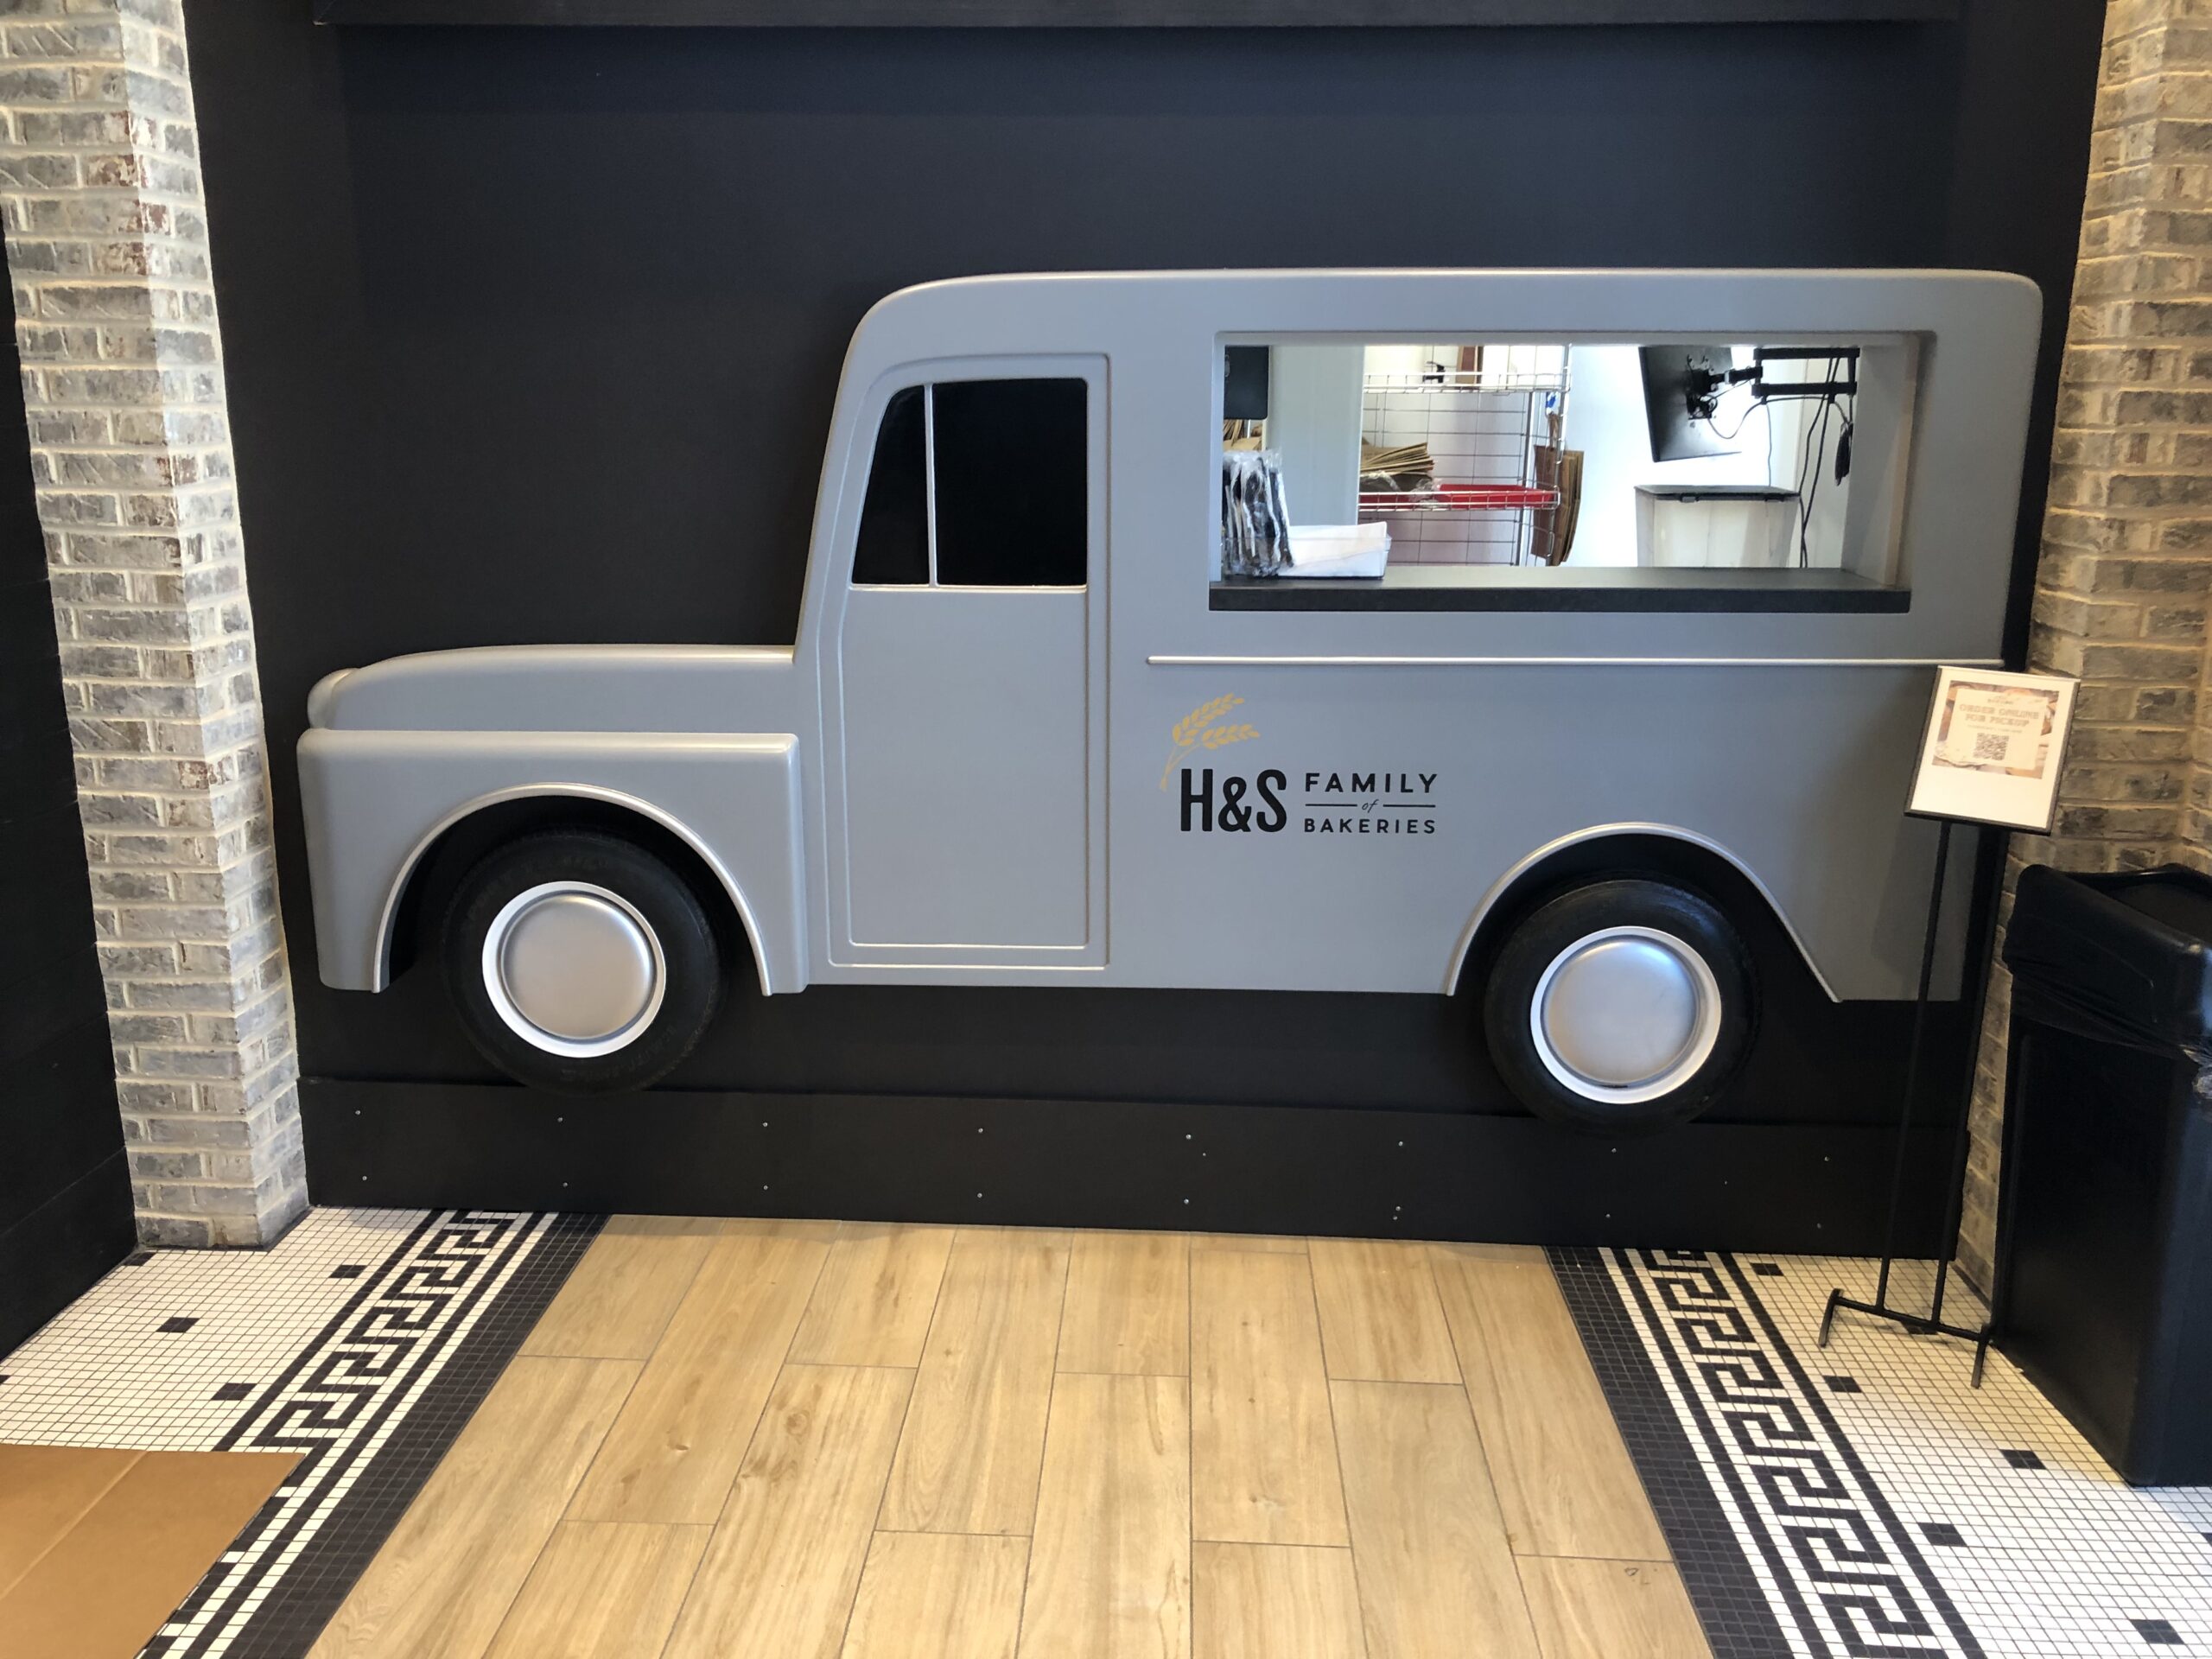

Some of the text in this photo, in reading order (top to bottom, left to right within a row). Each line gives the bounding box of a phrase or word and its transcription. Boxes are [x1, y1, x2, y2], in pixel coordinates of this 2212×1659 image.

[1305, 772, 1438, 793] FAMILY
[1180, 768, 1287, 833] H&S
[1361, 798, 1380, 814] of
[1304, 818, 1436, 834] BAKERIES
